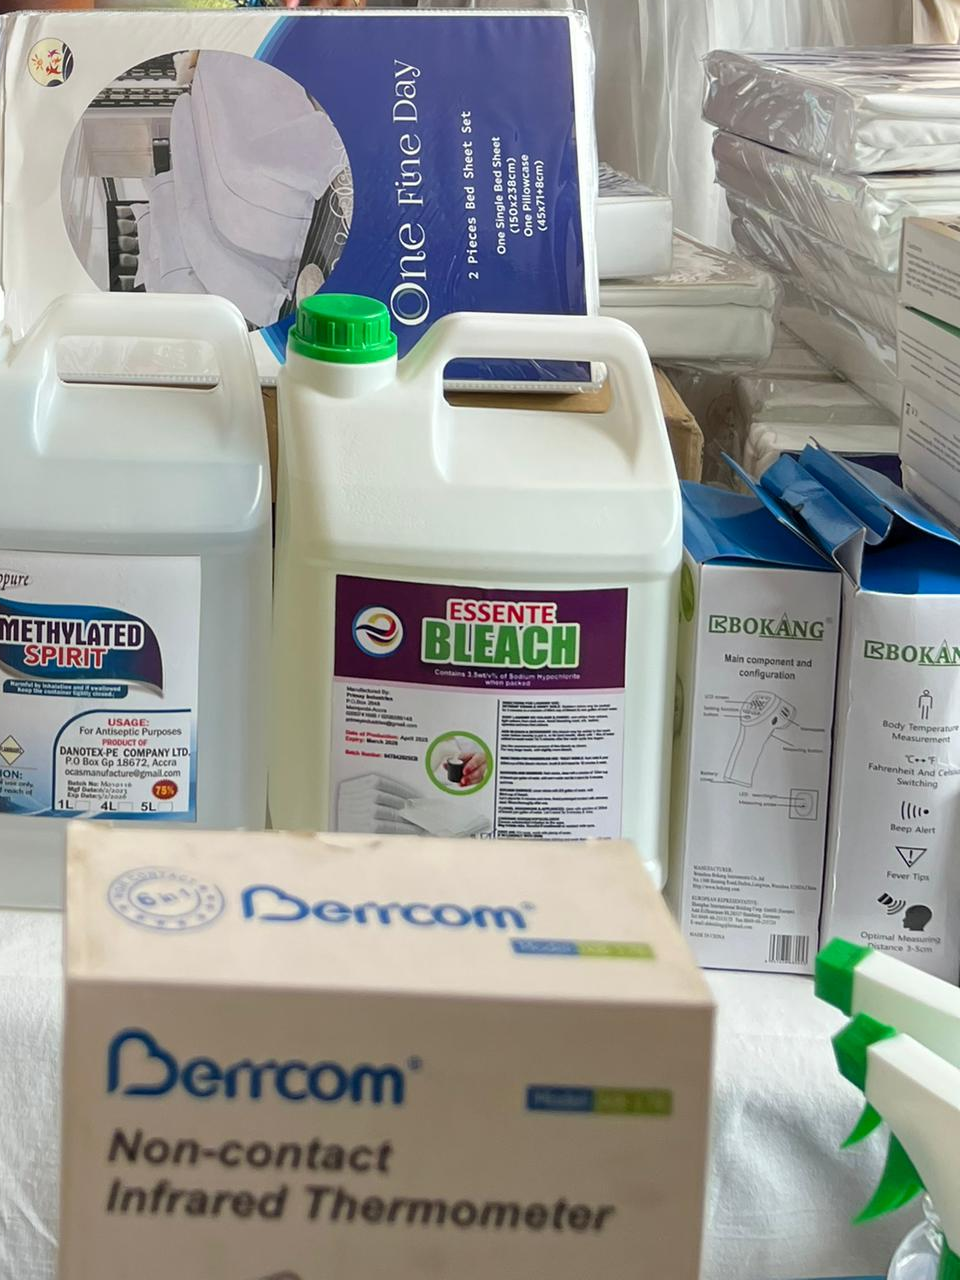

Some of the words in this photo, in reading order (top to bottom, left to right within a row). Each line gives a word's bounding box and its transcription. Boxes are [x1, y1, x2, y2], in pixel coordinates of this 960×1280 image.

[392, 59, 421, 124] Day
[460, 111, 472, 134] Set
[463, 141, 475, 179] Sheet
[491, 136, 502, 169] Sheet
[395, 133, 424, 207] Fine
[493, 170, 504, 193] Bed
[520, 154, 533, 214] Pillowcase
[464, 186, 476, 210] Bed
[506, 156, 521, 234] (150x238cm)
[533, 160, 549, 232] (45x71+8cm)
[495, 194, 507, 228] Single
[523, 215, 534, 237] One
[467, 217, 479, 264] Pieces
[496, 232, 507, 255] One
[390, 222, 430, 326] One
[468, 271, 479, 280] 2
[449, 601, 555, 624] ESSENTE
[728, 612, 825, 639] BOKANG
[424, 619, 578, 666] BLEACH
[24, 644, 108, 668] SPIRIT
[724, 653, 744, 663] Main
[746, 656, 794, 667] component
[796, 659, 812, 668] and
[434, 668, 466, 678] Contains
[500, 672, 508, 680] of
[508, 672, 535, 680] Sodium
[505, 679, 531, 687] packed
[739, 669, 796, 680] configuration
[79, 727, 93, 736] For
[95, 727, 139, 737] Antiseptic
[142, 727, 183, 738] Purposes
[107, 718, 150, 727] USAGE:
[882, 720, 905, 732] Body
[908, 722, 960, 734] Temperature
[102, 738, 136, 747] PRODUCT
[138, 739, 148, 747] OF
[892, 732, 951, 744] Measurement
[59, 746, 119, 757] DANOTEX-PE
[123, 747, 171, 758] COMPANY
[172, 747, 192, 757] LTD.
[65, 756, 80, 766] P.O
[82, 757, 99, 766] Box
[101, 757, 115, 768] Gp
[152, 759, 177, 767] Accra
[868, 762, 915, 776] Fahrenheit
[917, 769, 936, 777] And
[155, 786, 175, 796] 75%
[896, 777, 939, 789] Switching
[58, 799, 74, 810] 1L
[100, 800, 117, 811] 4L
[140, 801, 157, 812] 5L
[890, 823, 913, 834] Beep
[915, 825, 936, 834] Alert
[887, 870, 909, 881] Fever
[912, 872, 930, 882] Tips
[240, 883, 527, 930] Berrcom
[860, 930, 895, 942] Optimal
[897, 934, 942, 945] Measuring
[867, 942, 903, 953] Distance
[906, 945, 933, 953] 3-5cm
[107, 1026, 405, 1105] Berrcom
[106, 1127, 394, 1174] Non-contact
[105, 1178, 290, 1220] Infrared
[304, 1183, 617, 1234] Thermometer
